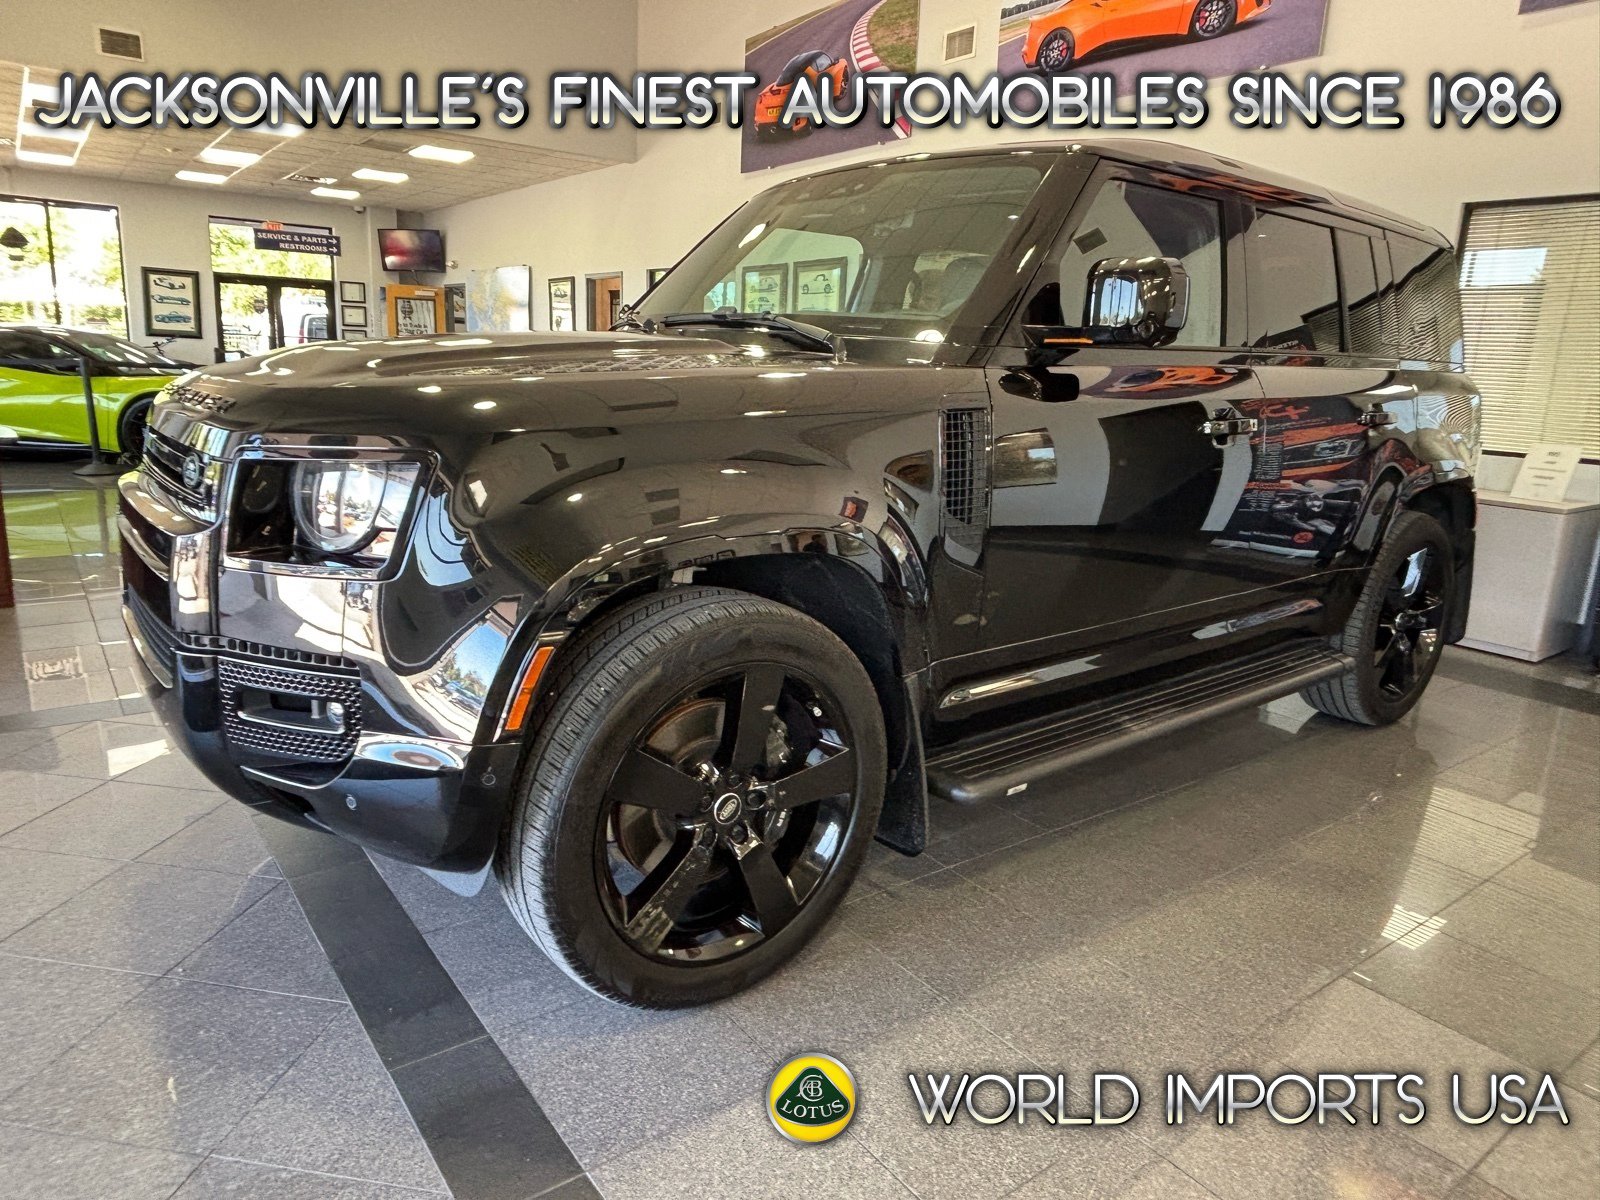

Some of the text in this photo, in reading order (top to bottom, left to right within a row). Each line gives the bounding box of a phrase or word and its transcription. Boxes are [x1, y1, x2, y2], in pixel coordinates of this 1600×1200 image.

[257, 232, 292, 241] SERVICE
[301, 235, 328, 244] PARTS
[279, 242, 328, 253] RESTROOMS
